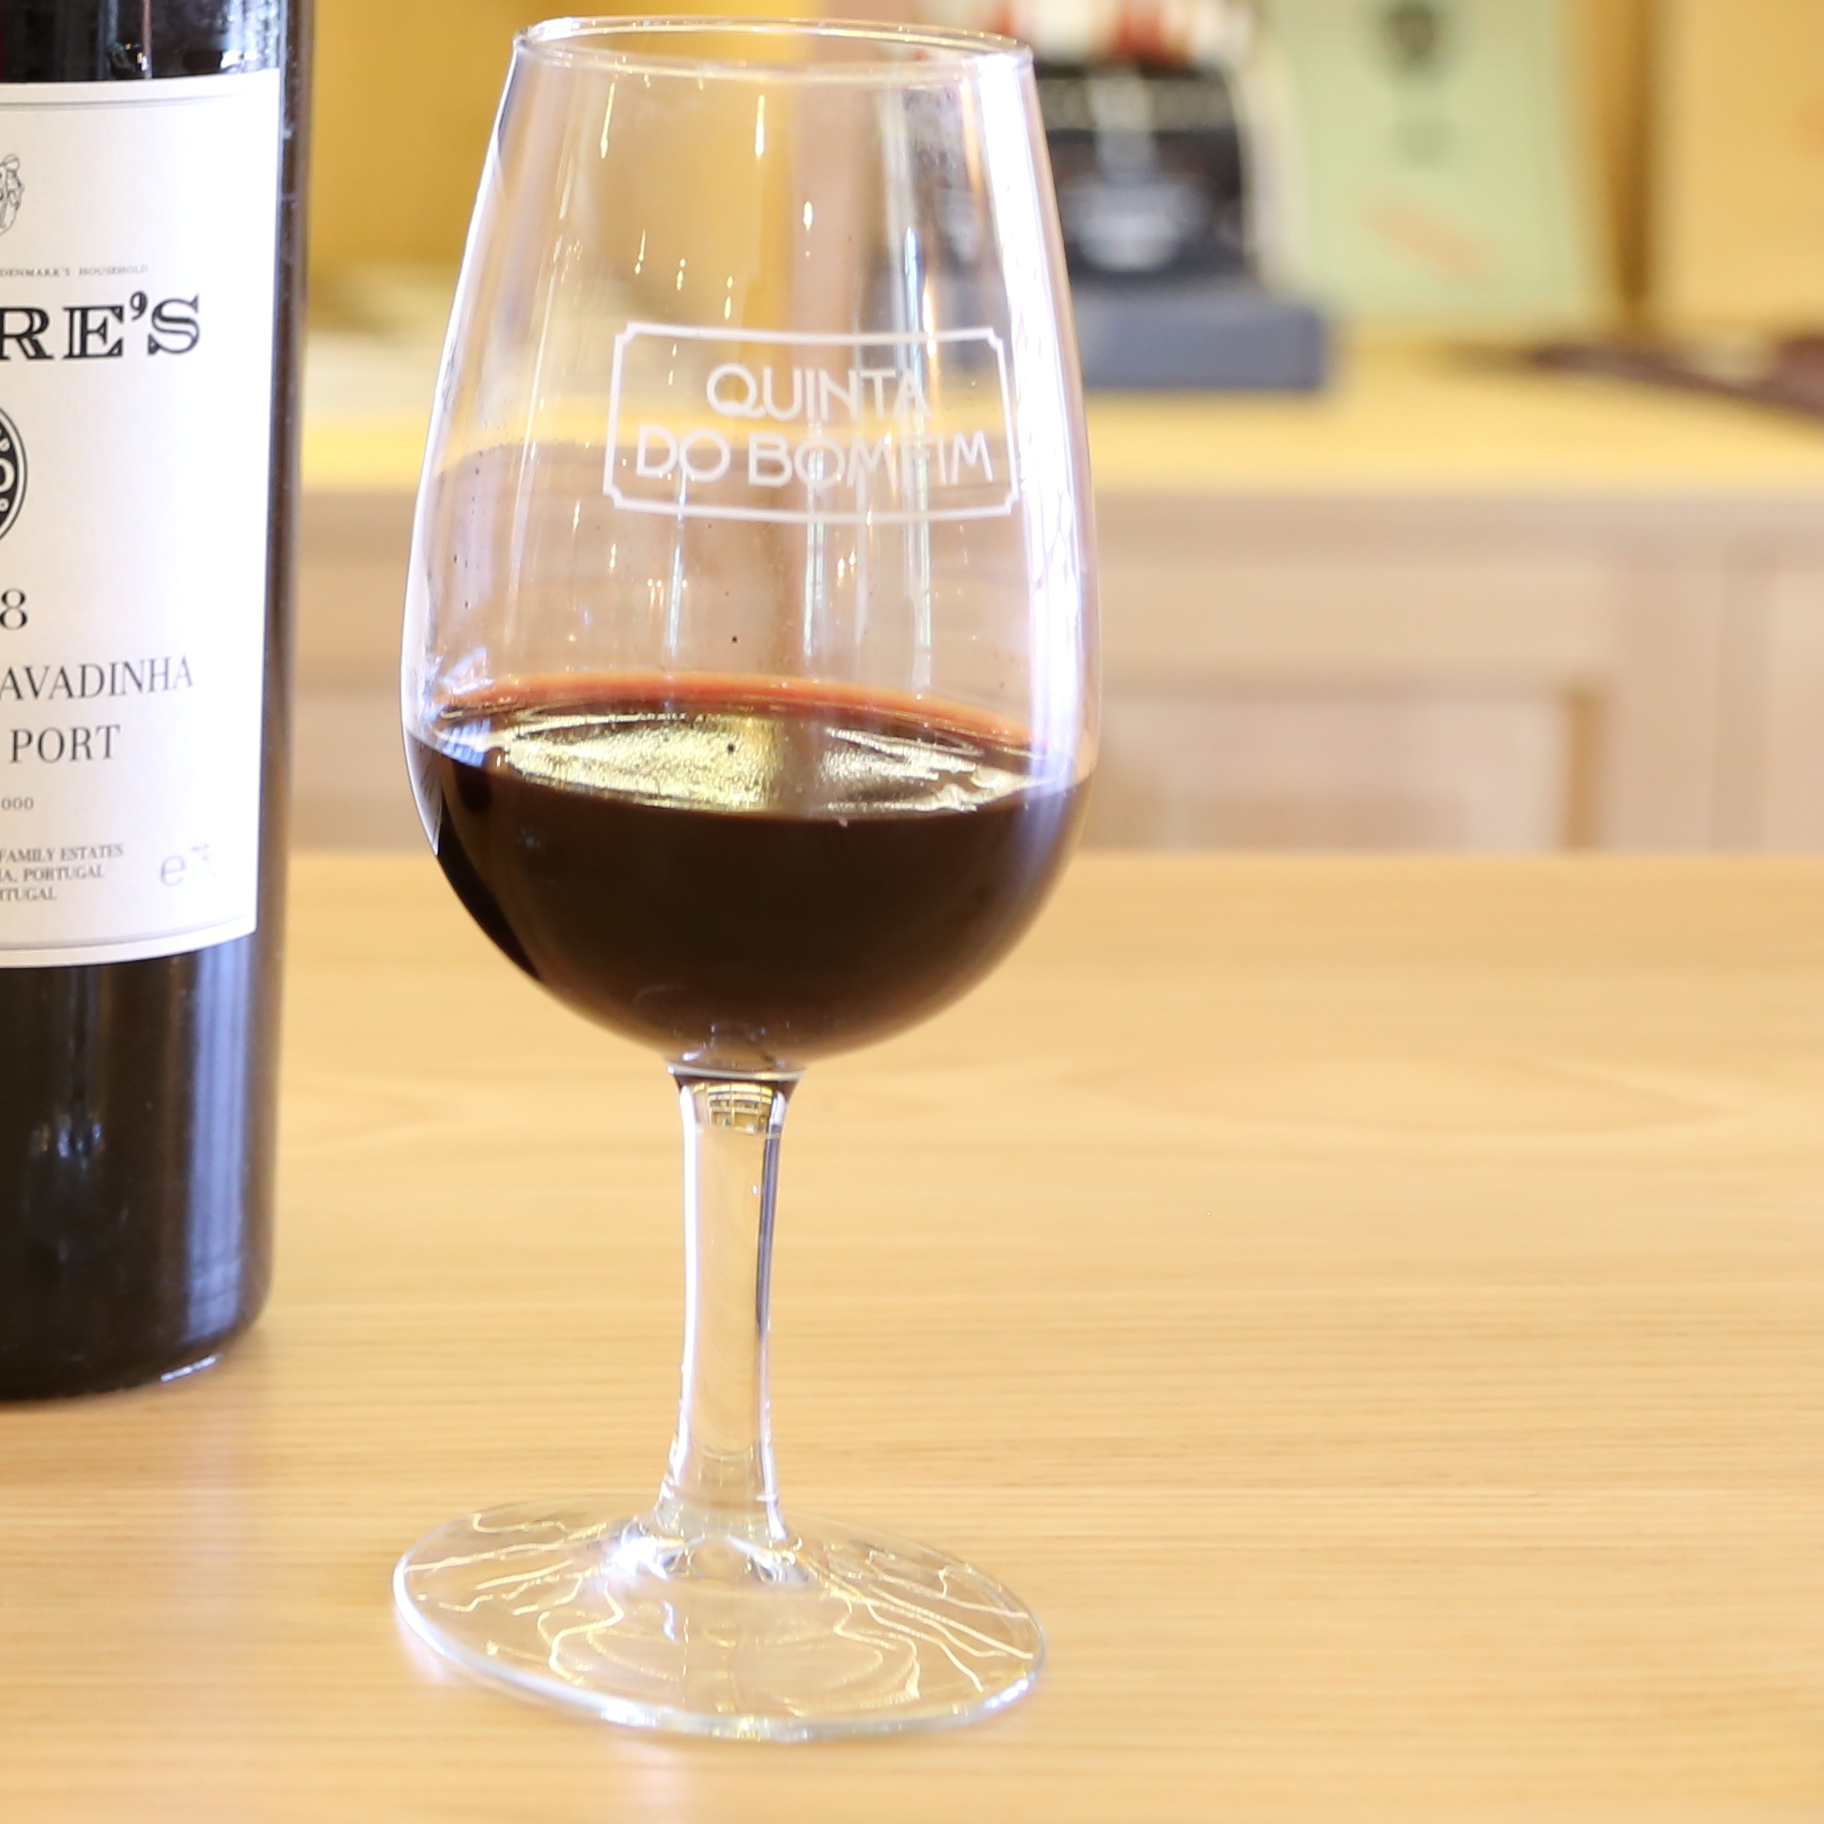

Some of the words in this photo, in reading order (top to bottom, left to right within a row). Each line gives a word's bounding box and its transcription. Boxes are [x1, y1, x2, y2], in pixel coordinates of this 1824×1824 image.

[705, 362, 933, 423] QUINTA
[634, 423, 732, 484] DO
[747, 428, 995, 491] BOMFIM
[9, 724, 122, 764] PORT
[60, 843, 125, 861] ESTATES
[22, 865, 106, 883] PORTUGAL
